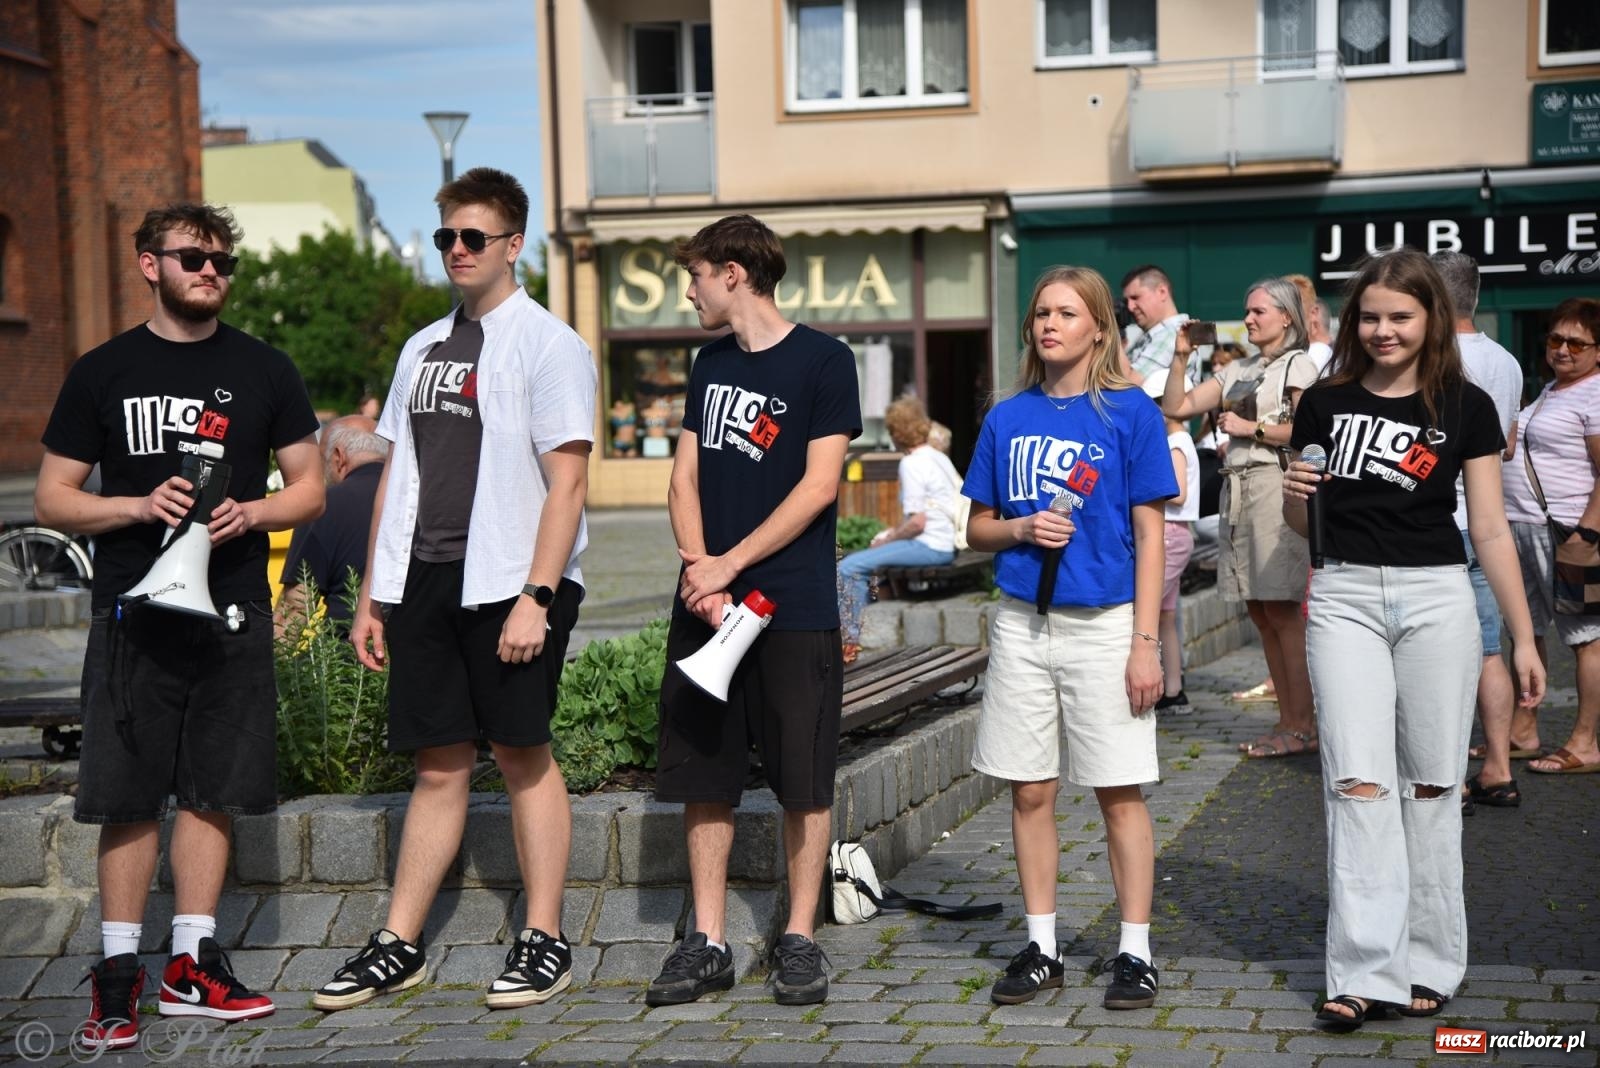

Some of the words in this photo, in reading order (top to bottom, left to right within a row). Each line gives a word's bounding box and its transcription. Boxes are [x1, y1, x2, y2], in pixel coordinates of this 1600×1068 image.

[161, 396, 229, 440] LOVE
[725, 387, 780, 449] LOVE
[1037, 437, 1098, 496] LOVE
[1366, 417, 1438, 480] LOVE
